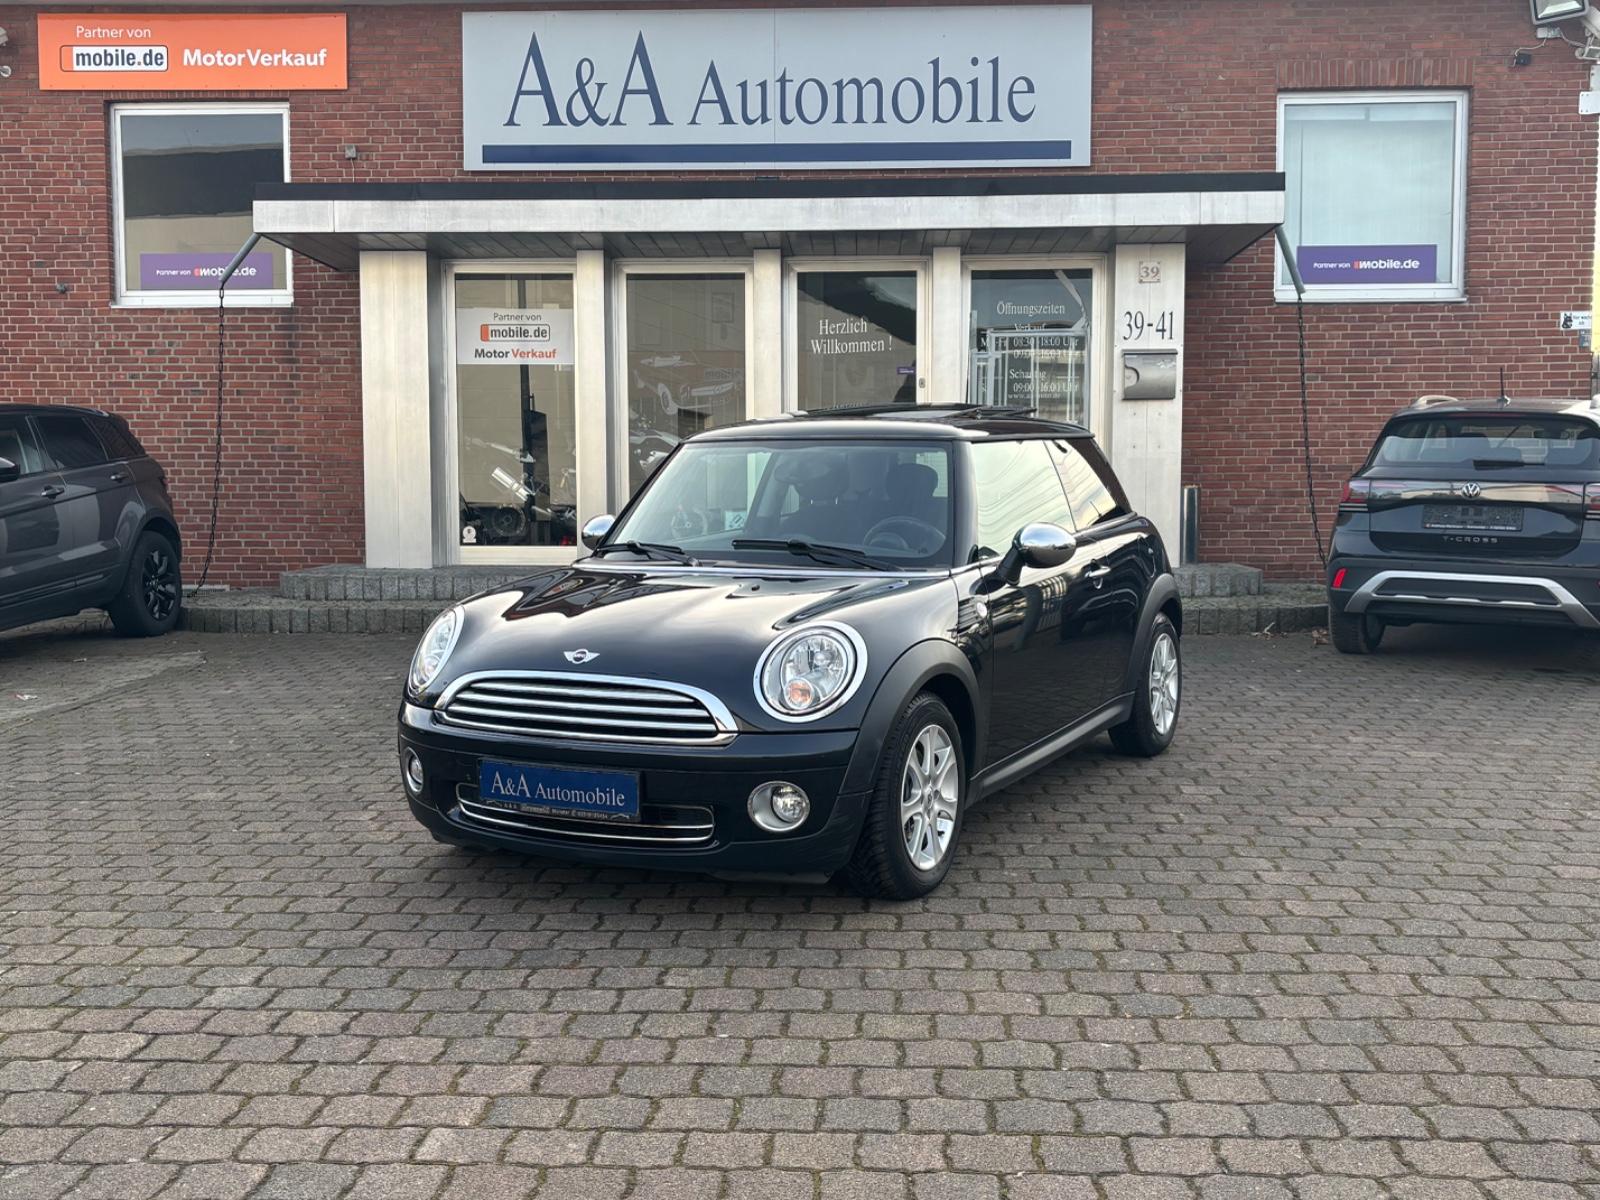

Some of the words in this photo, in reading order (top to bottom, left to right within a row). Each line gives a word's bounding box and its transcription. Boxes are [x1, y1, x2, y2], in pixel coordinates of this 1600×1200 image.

[76, 26, 123, 38] Partner
[127, 29, 151, 38] von
[75, 49, 164, 67] mobile.de
[503, 30, 674, 127] A&A
[687, 56, 1037, 126] Automobile
[1141, 266, 1160, 279] 39
[1359, 259, 1420, 269] mobile.de
[493, 312, 523, 321] Partner
[1123, 310, 1174, 340] 39-41
[490, 327, 547, 338] mobile.de
[819, 317, 868, 335] Herzlich
[811, 338, 885, 355] Willkommen
[491, 771, 531, 798] A&A
[535, 782, 625, 806] Automobile
